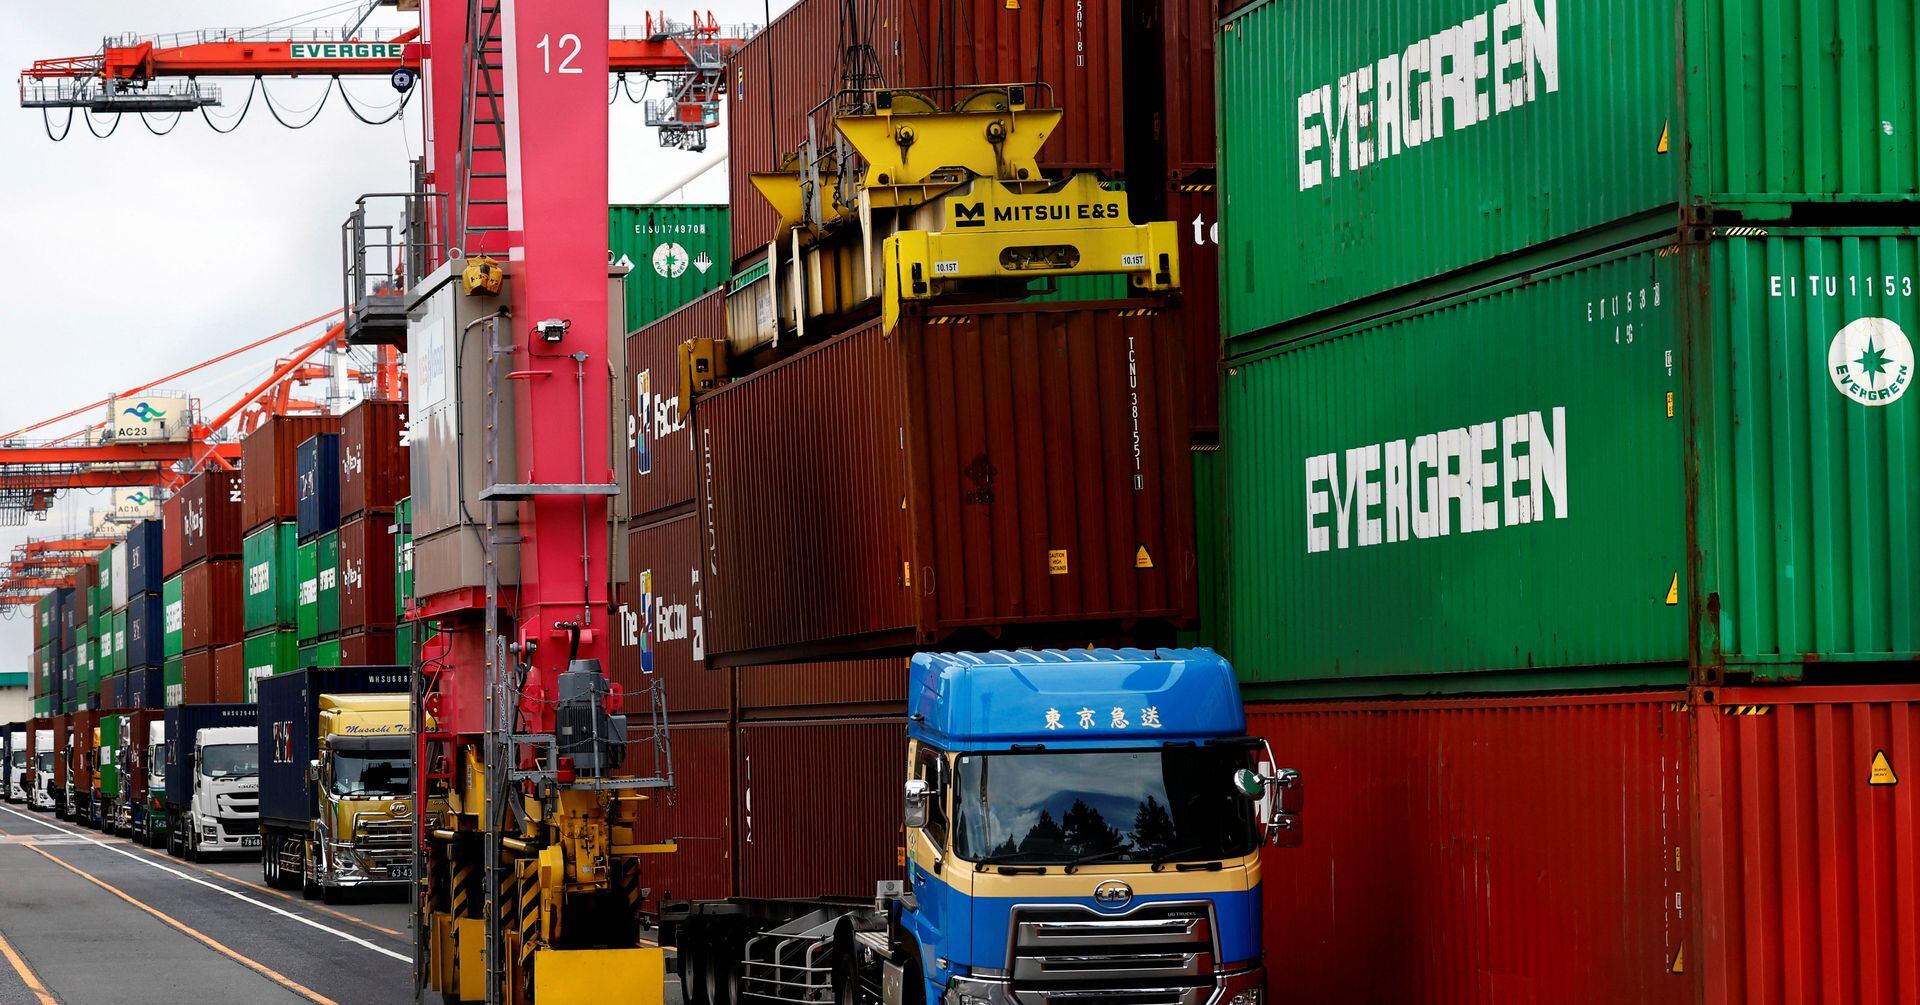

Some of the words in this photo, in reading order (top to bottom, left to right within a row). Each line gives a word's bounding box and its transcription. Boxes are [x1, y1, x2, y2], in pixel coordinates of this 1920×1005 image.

[291, 44, 401, 58] EVERGRE
[536, 33, 583, 74] 12
[1297, 0, 1559, 192] EVERGREEN
[994, 205, 1070, 221] MITSUI
[1077, 203, 1119, 218] E&S
[635, 224, 706, 234] EISU1749708
[936, 262, 957, 273] 10.15T
[1123, 255, 1144, 265] 10.15T
[1128, 336, 1137, 388] TCNU
[1835, 364, 1908, 401] EVERGREEN
[118, 427, 148, 437] AC23
[1131, 393, 1140, 470] 381551
[1305, 406, 1568, 554] EVERGREEN
[118, 505, 140, 513] AC16
[619, 602, 638, 647] The
[346, 725, 390, 733] Musashi
[1044, 705, 1163, 731] 東京急送
